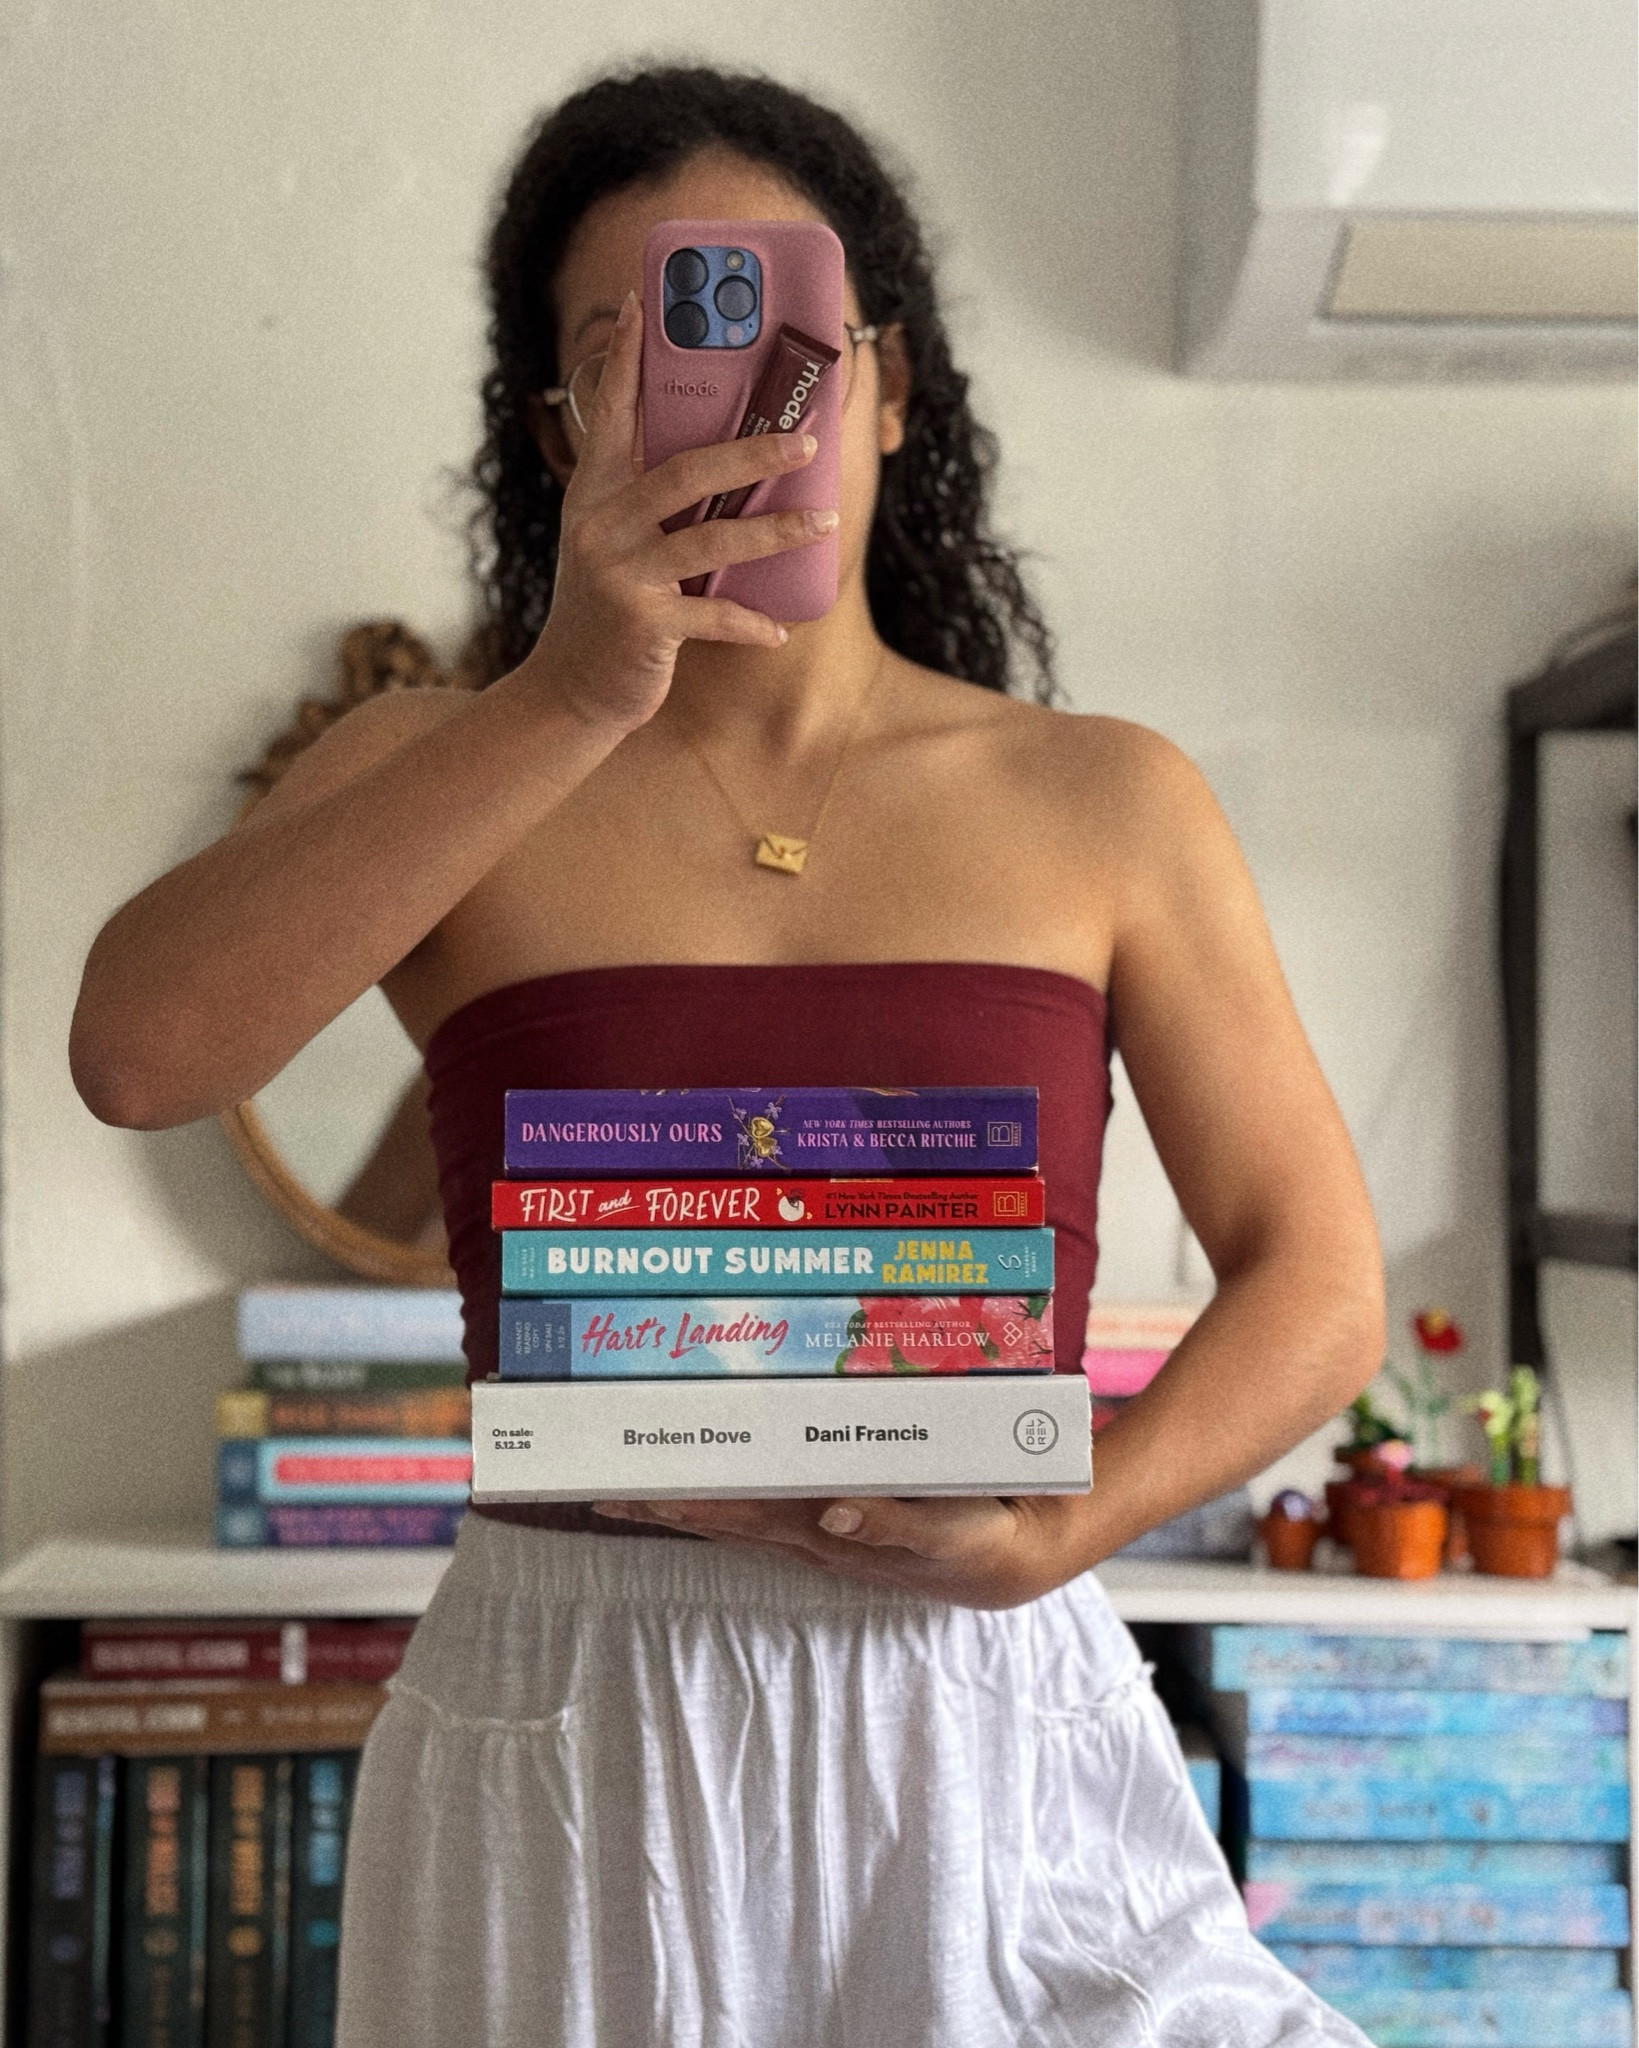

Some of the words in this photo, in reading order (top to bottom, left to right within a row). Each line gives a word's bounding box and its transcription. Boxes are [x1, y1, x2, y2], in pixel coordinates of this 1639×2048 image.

[664, 378, 719, 396] rhode
[778, 360, 822, 430] rhode
[521, 1122, 662, 1143] DANGEROUSLY
[669, 1122, 723, 1143] OURS
[803, 1119, 823, 1129] NEW
[824, 1119, 846, 1129] YORK
[849, 1119, 875, 1129] TIMES
[876, 1119, 932, 1129] BESTSELLING
[932, 1119, 973, 1129] AUTHORS
[797, 1132, 848, 1148] KRISTA
[852, 1132, 865, 1148] &
[869, 1132, 917, 1148] BECCA
[920, 1132, 978, 1148] RITCHIE
[519, 1187, 595, 1223] FIRST
[597, 1189, 633, 1213] and
[645, 1186, 761, 1222] FOREVER
[838, 1191, 856, 1200] New
[858, 1191, 876, 1200] York
[878, 1191, 901, 1200] Times
[903, 1191, 949, 1202] Bestselling
[950, 1191, 979, 1200] Author
[825, 1202, 880, 1219] LYNN
[885, 1202, 979, 1219] PAINTER
[893, 1240, 974, 1261] JENNA
[547, 1246, 713, 1275] BURNOUT
[724, 1246, 874, 1275] SUMMER
[882, 1263, 989, 1285] RAMIREZ
[843, 1320, 873, 1329] TODAY
[874, 1320, 932, 1329] BESTSELLING
[933, 1320, 972, 1329] AUTHOR
[581, 1312, 667, 1358] Hart's
[668, 1311, 790, 1360] Landing
[804, 1332, 895, 1348] MELANIE
[901, 1331, 991, 1348] HARLOW
[491, 1428, 508, 1438] On
[508, 1428, 534, 1438] sale:
[623, 1428, 696, 1446] Broken
[699, 1427, 752, 1445] Dove
[804, 1425, 851, 1443] Dani
[854, 1424, 929, 1442] Francis
[1025, 1419, 1036, 1446] DEL
[1037, 1417, 1047, 1446] REY
[494, 1440, 531, 1450] 5.12.26
